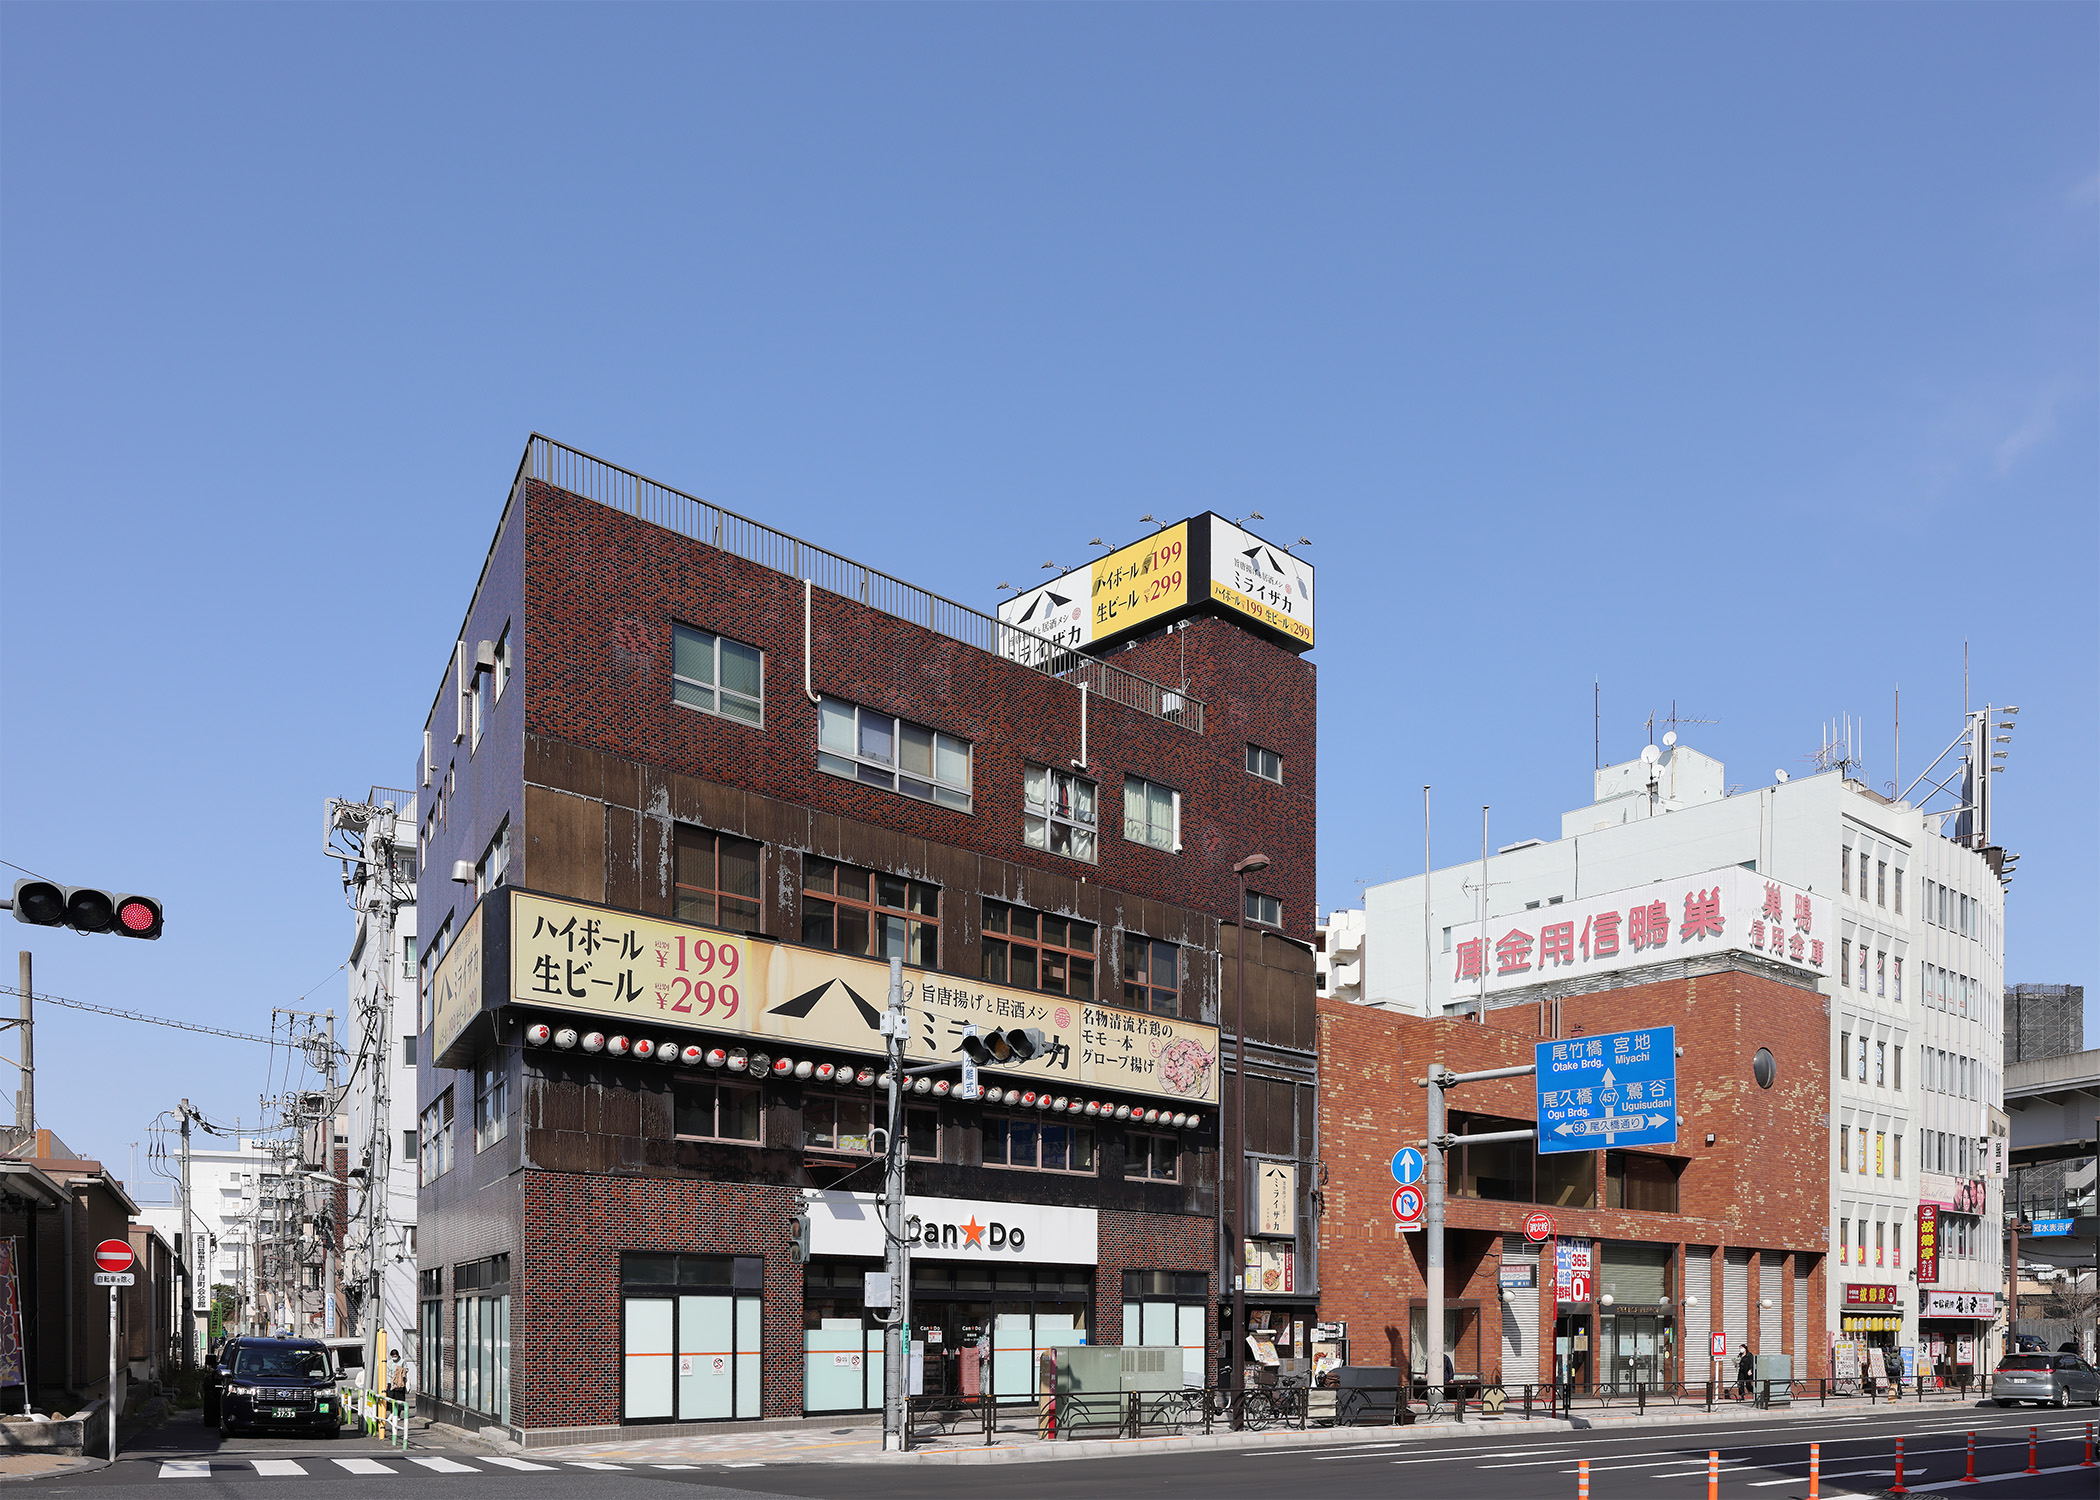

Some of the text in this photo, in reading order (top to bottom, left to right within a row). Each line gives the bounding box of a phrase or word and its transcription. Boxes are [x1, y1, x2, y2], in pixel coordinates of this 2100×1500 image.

[1096, 562, 1140, 593] ハイボール
[1234, 570, 1292, 613] ミライザカ
[1096, 590, 1140, 624] 生ビール
[1214, 586, 1241, 606] ハイボール
[1265, 609, 1290, 629] 生ビール
[1762, 880, 1812, 932] 巣鴨
[532, 915, 644, 961] ハイボール
[1748, 918, 1825, 969] 信用金庫
[532, 954, 644, 1003] 生ビール
[922, 983, 1049, 1020] 旨唐揚げと居酒メシ
[1082, 1007, 1173, 1038] 名物清流若鶏の
[922, 1011, 1070, 1070] ミラカ
[1082, 1029, 1134, 1052] モモ一本
[1552, 1033, 1651, 1061] 尾竹橋 宮地
[1082, 1049, 1155, 1074] グローブ揚げ
[1552, 1052, 1650, 1072] Otake Brdg. Miyachi
[1543, 1088, 1593, 1108] 尾久橋
[1602, 1092, 1616, 1103] 457
[1626, 1080, 1666, 1100] 鶯谷
[1547, 1107, 1590, 1121] Ogu Brdg.
[1621, 1097, 1672, 1112] Uguisudani
[1574, 1123, 1585, 1133] 58
[1589, 1118, 1640, 1131] 尾久橋通り
[1529, 1222, 1548, 1233] 消火栓
[2033, 1222, 2073, 1232] 冠水表示板
[1572, 1240, 1591, 1252] ATM
[1572, 1253, 1587, 1267] 365
[97, 1275, 131, 1283] 自転車を除く
[1571, 1271, 1590, 1279] いつでも
